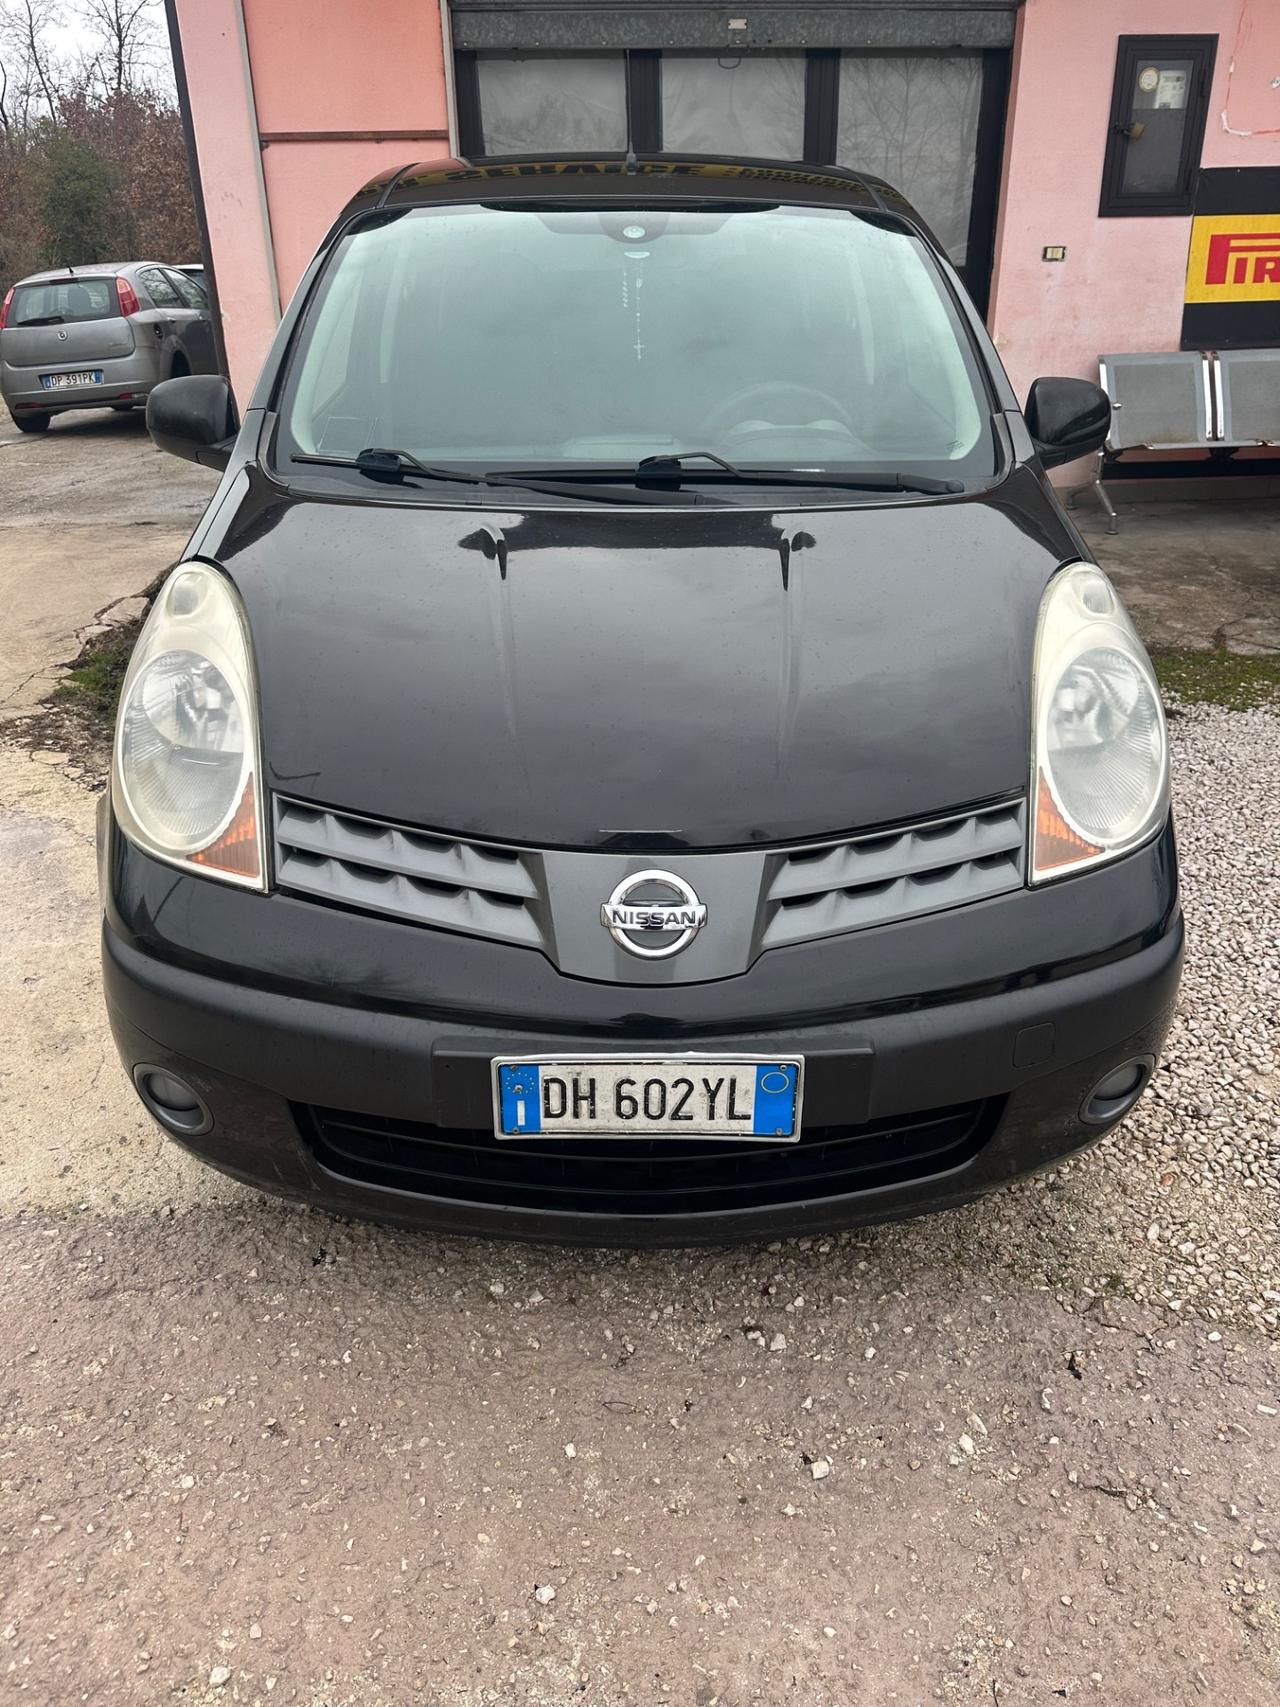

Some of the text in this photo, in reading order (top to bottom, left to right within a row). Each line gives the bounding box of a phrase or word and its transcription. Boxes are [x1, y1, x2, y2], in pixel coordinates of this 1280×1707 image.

[51, 371, 94, 386] DP 391PK
[612, 910, 696, 925] NISSAN
[543, 1077, 596, 1119] DH
[614, 1077, 751, 1121] 602YL
